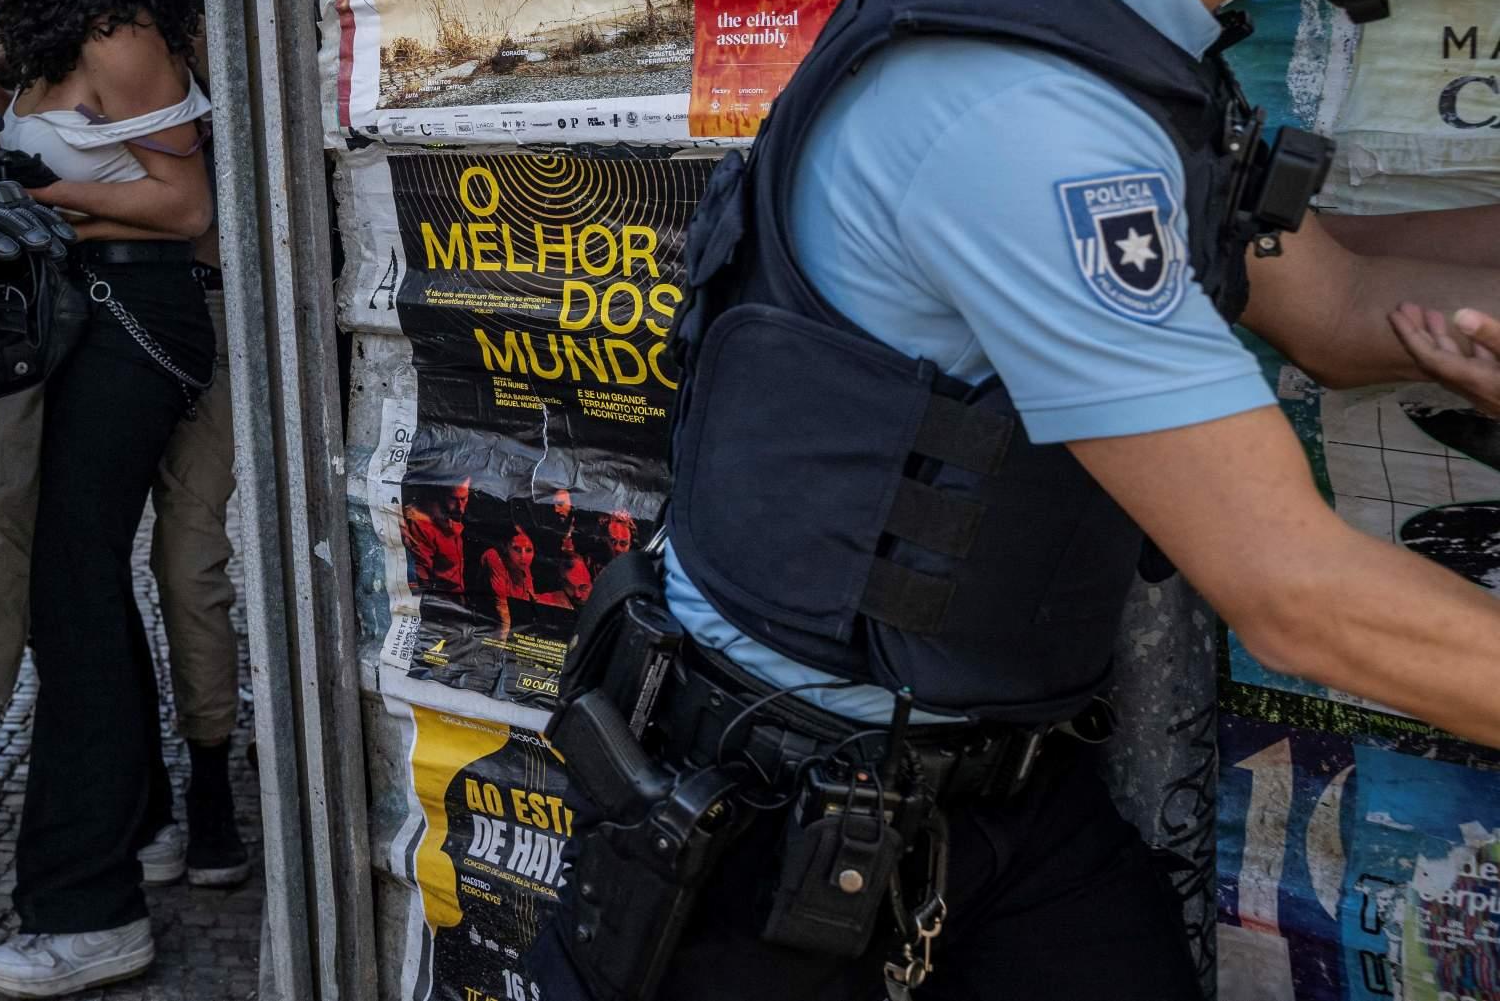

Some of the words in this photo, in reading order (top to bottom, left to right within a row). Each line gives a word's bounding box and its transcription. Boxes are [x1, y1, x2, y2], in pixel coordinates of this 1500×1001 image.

[717, 12, 742, 28] the
[746, 10, 798, 28] ethical
[716, 27, 789, 49] assembly
[459, 166, 500, 217] O
[1083, 181, 1153, 206] POLÍCIA
[420, 222, 660, 278] MELHOR
[559, 280, 683, 337] DOS
[473, 328, 679, 390] MUNDO
[493, 379, 507, 388] RITA
[508, 381, 529, 391] NUNES
[495, 391, 513, 400] SARA
[496, 399, 520, 408] MIGUEL
[520, 402, 543, 411] NUNES
[577, 388, 583, 397] E
[584, 389, 596, 399] SE
[597, 390, 610, 400] UM
[611, 393, 648, 406] GRANDE
[579, 398, 631, 414] TERRAMOTO
[631, 405, 666, 418] VOLTAR
[583, 407, 589, 416] A
[590, 408, 645, 424] ACONTECER?
[522, 677, 532, 687] 10
[532, 680, 559, 694] OUTU
[465, 778, 504, 817] AO
[467, 814, 507, 865] DE
[461, 874, 491, 892] MAESTRO
[463, 857, 491, 875] CONCERTO
[531, 881, 558, 898] TEMPORA
[461, 883, 481, 899] PEDRO
[481, 890, 501, 906] NEVES
[502, 968, 526, 1001] 16
